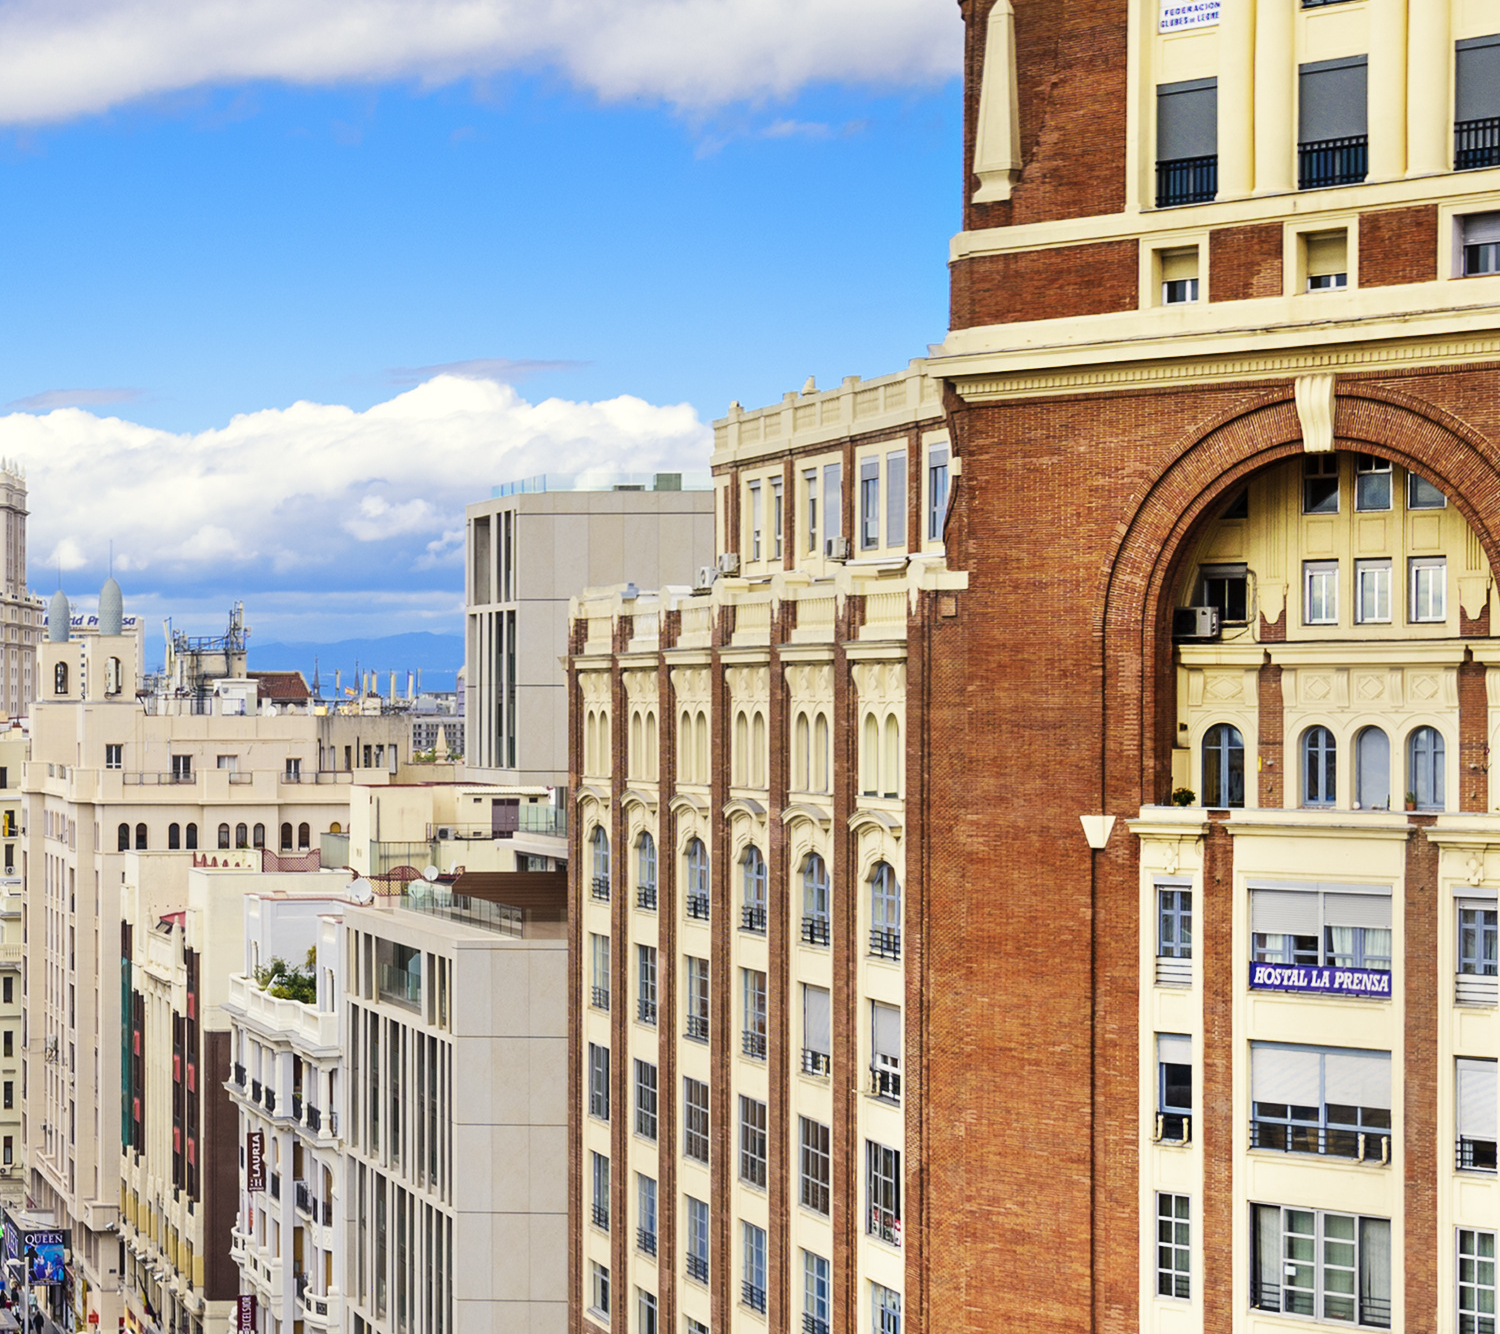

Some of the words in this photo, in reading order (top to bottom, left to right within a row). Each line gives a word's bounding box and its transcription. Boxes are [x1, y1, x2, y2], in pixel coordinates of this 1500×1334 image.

[87, 615, 136, 626] Prsa
[1253, 967, 1308, 986] HOSTAL
[1310, 970, 1330, 987] LA
[1333, 971, 1389, 992] PRENSA
[252, 1134, 261, 1178] LAURIA
[25, 1234, 63, 1245] QUEEN
